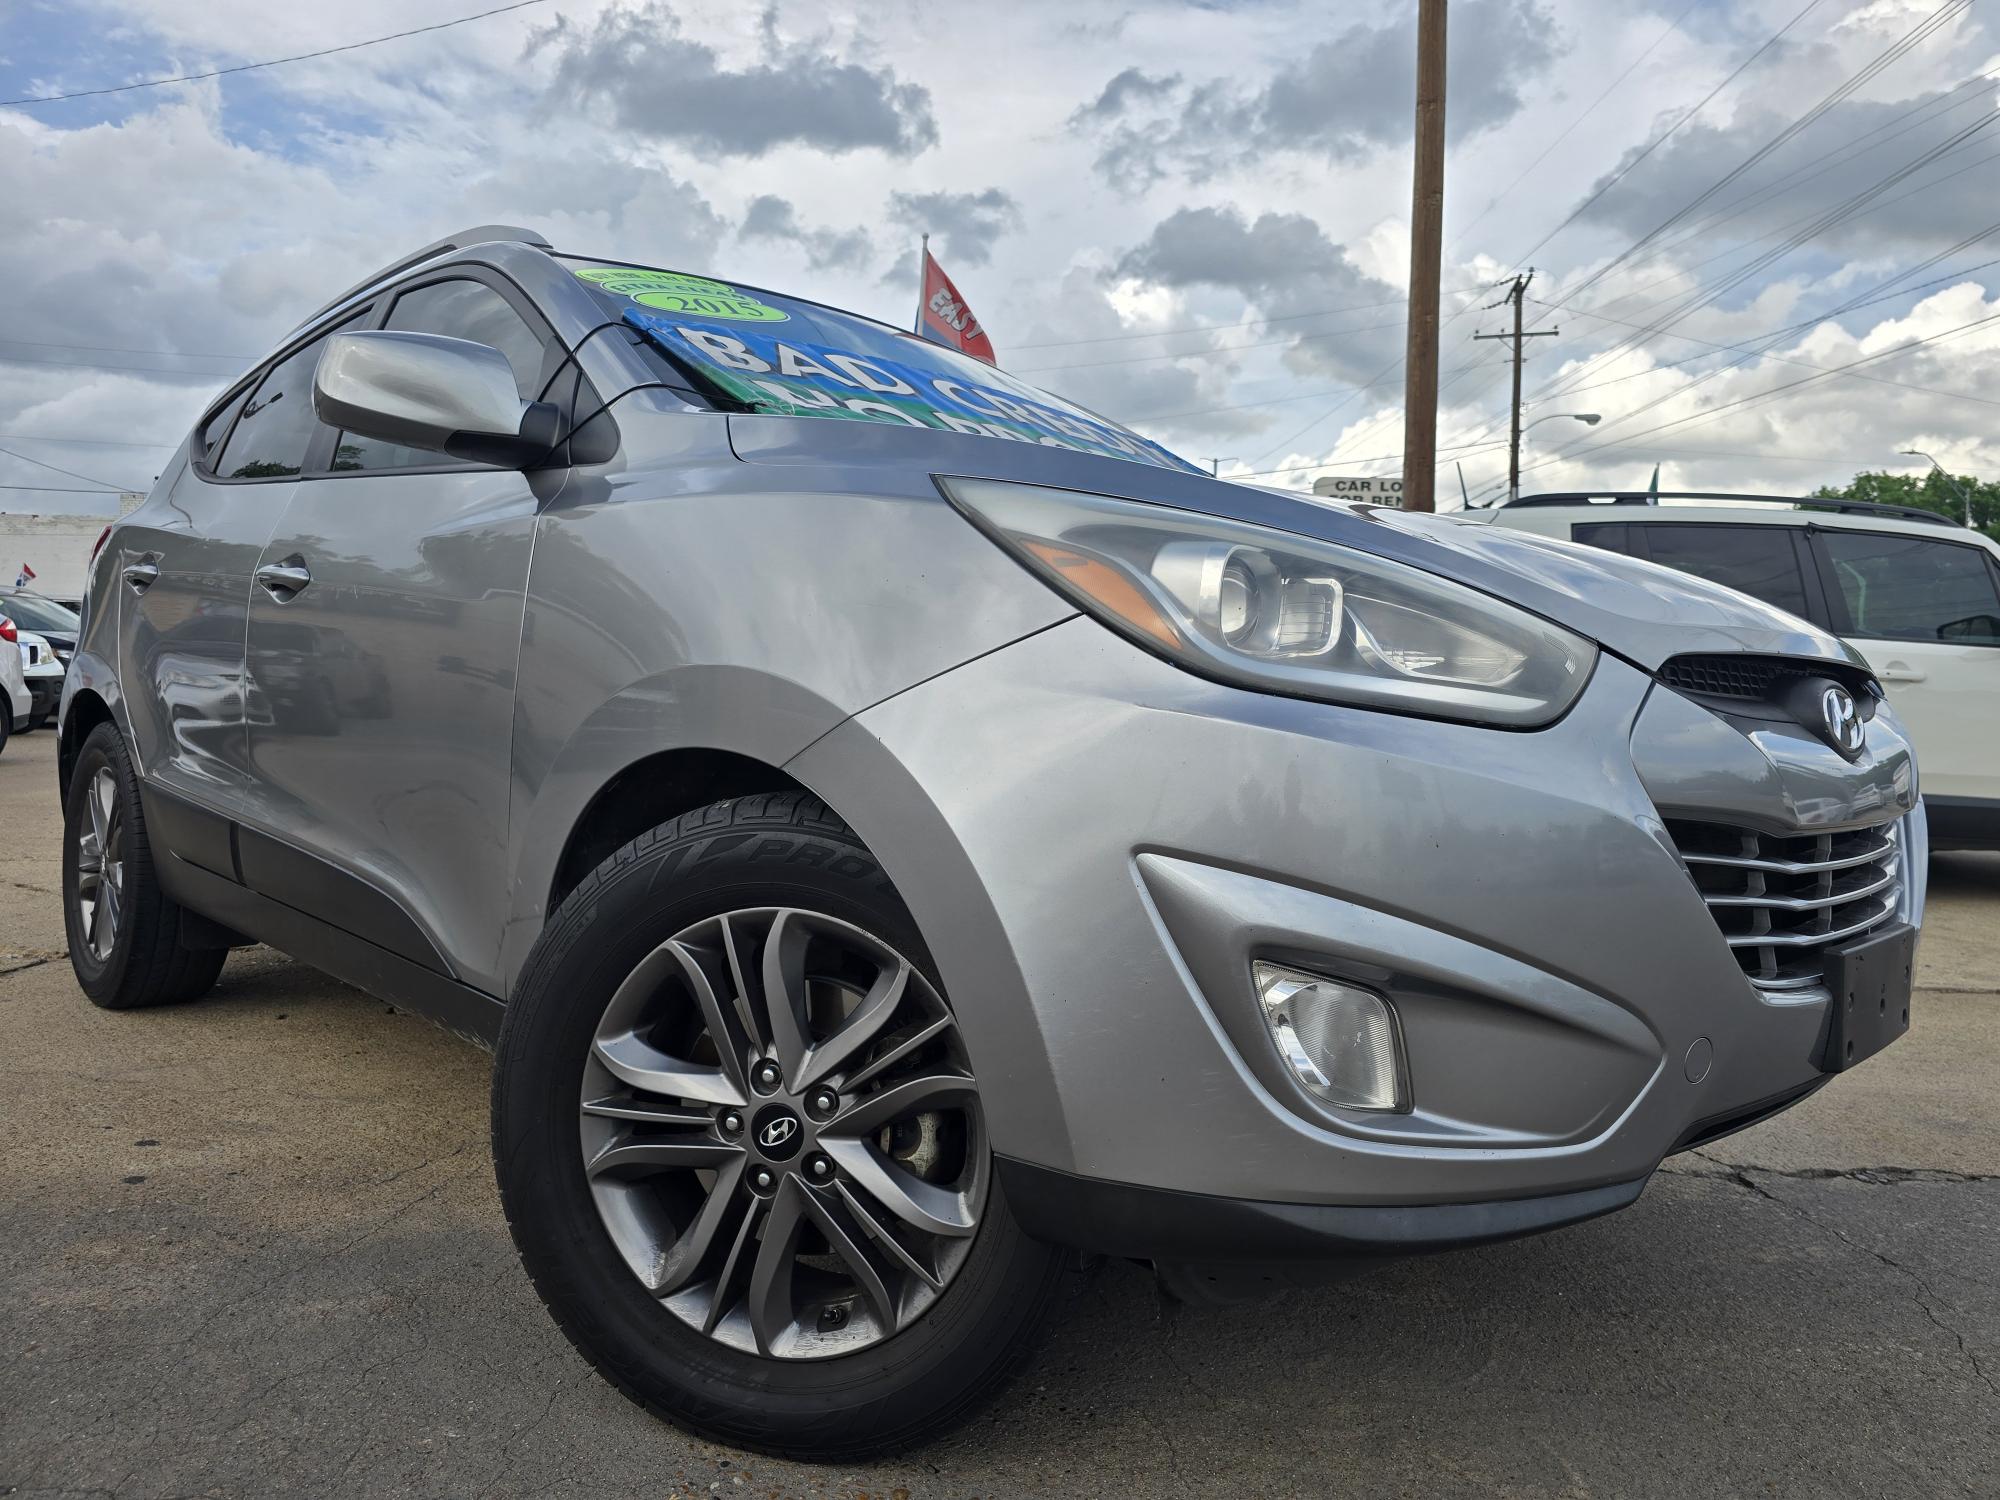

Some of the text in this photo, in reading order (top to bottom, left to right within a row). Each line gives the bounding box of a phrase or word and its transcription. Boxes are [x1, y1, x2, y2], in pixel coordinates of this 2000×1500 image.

[666, 296, 764, 317] 2015
[928, 287, 984, 340] EASY
[676, 327, 915, 395] BAD
[1335, 480, 1372, 492] CAR
